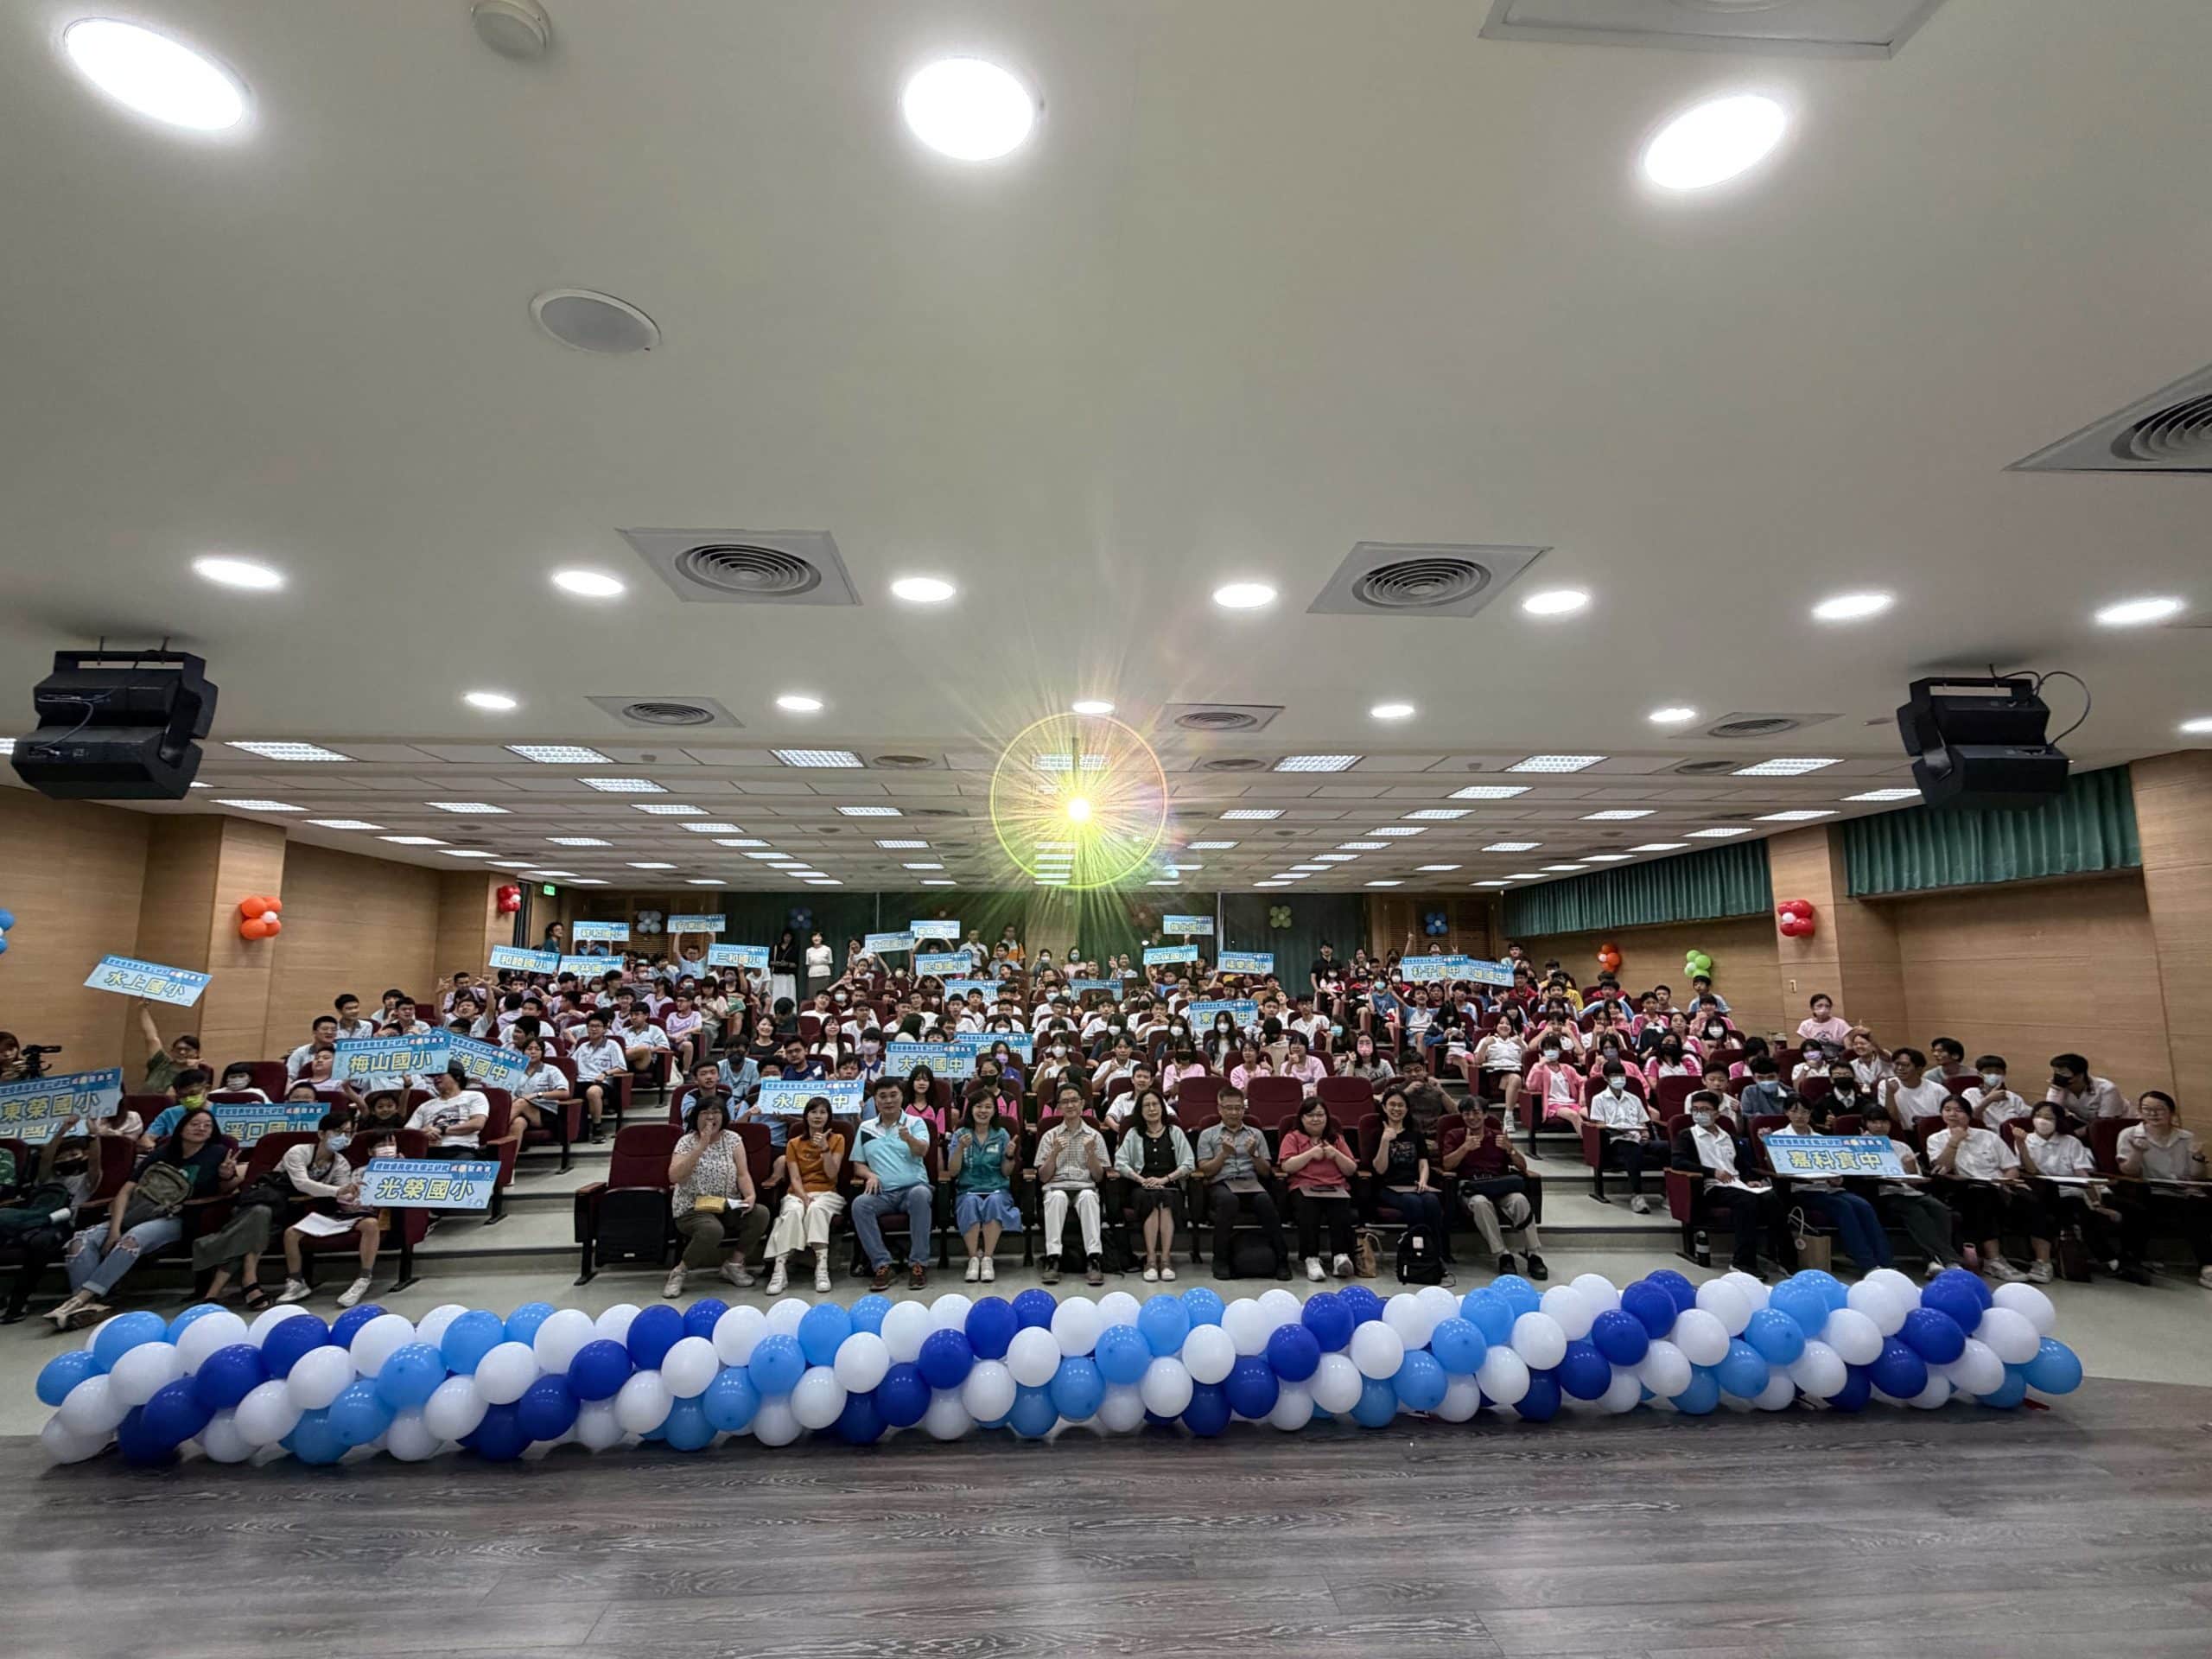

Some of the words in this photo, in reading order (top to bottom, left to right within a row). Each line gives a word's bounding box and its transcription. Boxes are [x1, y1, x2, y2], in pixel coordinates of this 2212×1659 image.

[105, 969, 185, 998] 水上國小
[349, 1049, 432, 1073] 梅山國小
[2, 1090, 100, 1122] 東榮國小
[773, 1092, 849, 1109] 永慶中
[1787, 1149, 1882, 1169] 嘉科實中
[374, 1176, 474, 1201] 光榮國小
